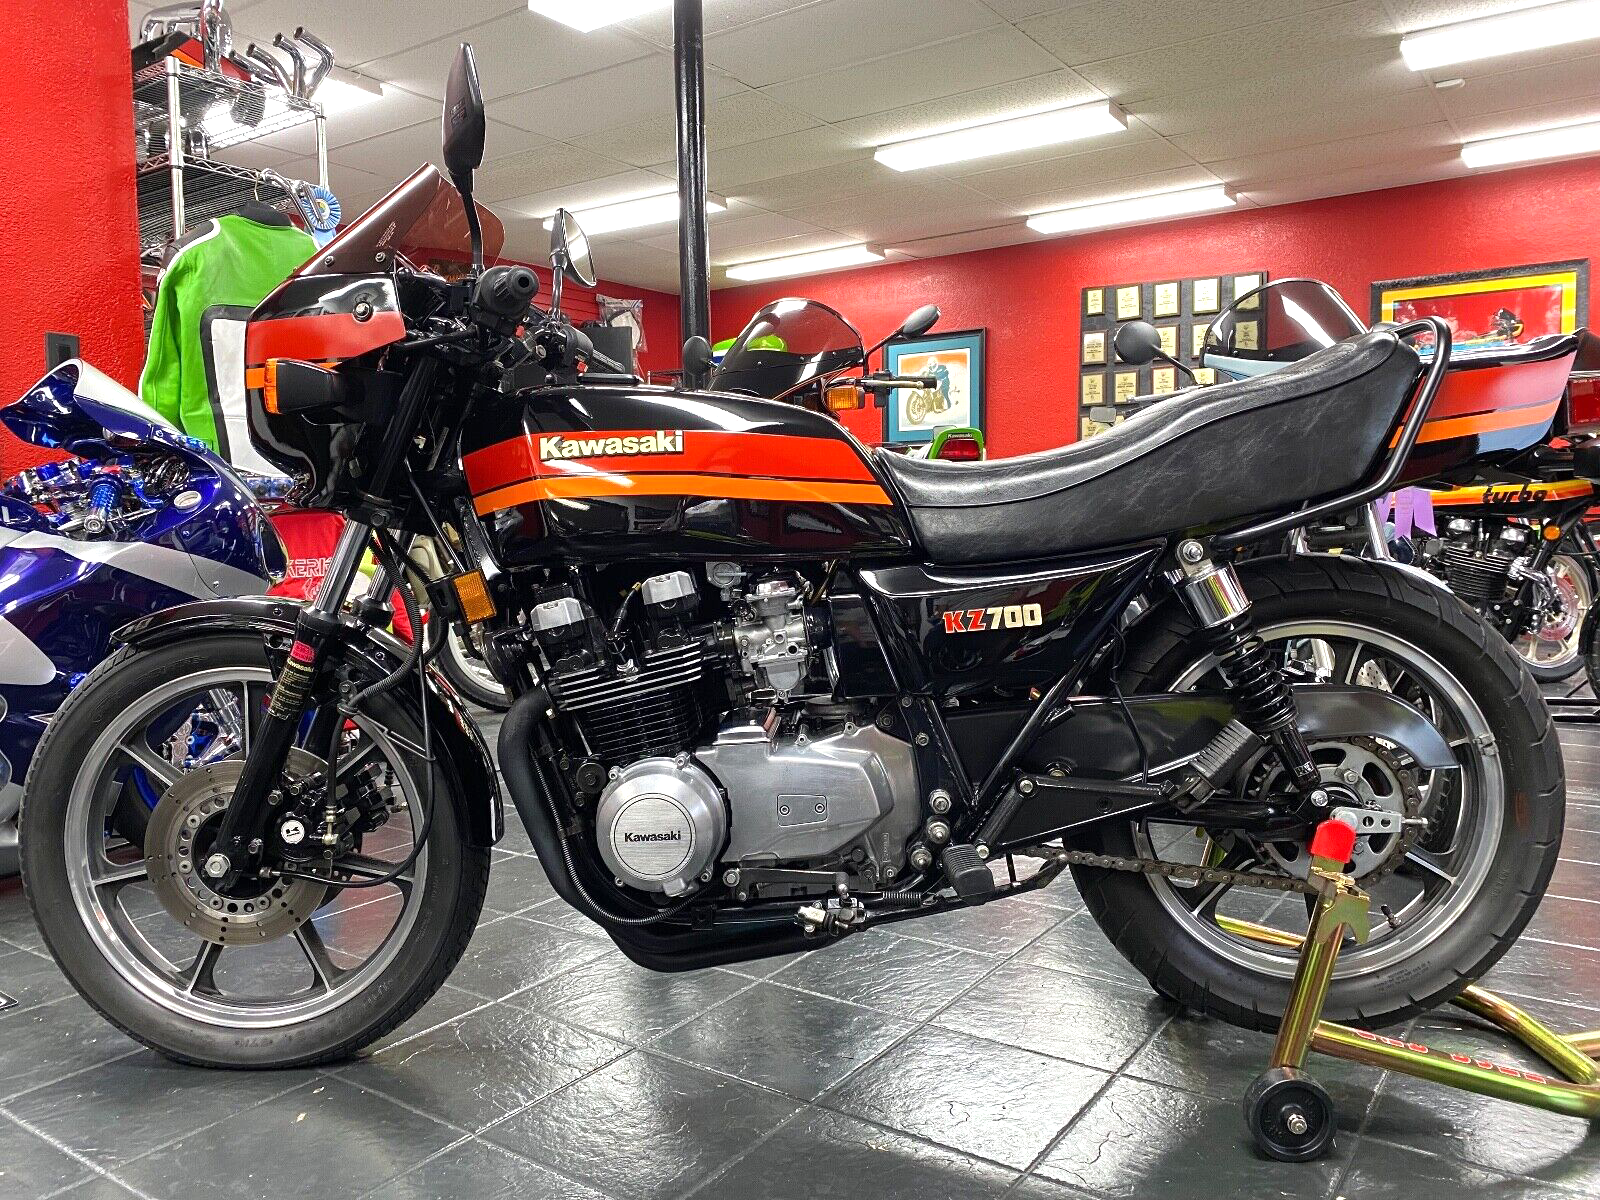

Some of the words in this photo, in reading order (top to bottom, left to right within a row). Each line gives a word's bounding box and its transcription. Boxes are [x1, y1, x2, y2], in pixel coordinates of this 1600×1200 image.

[539, 430, 684, 461] Kawasaki
[1482, 484, 1548, 504] turbo
[942, 603, 1043, 634] KZ700
[286, 656, 315, 673] Kawasaki
[624, 830, 682, 843] Kawasaki
